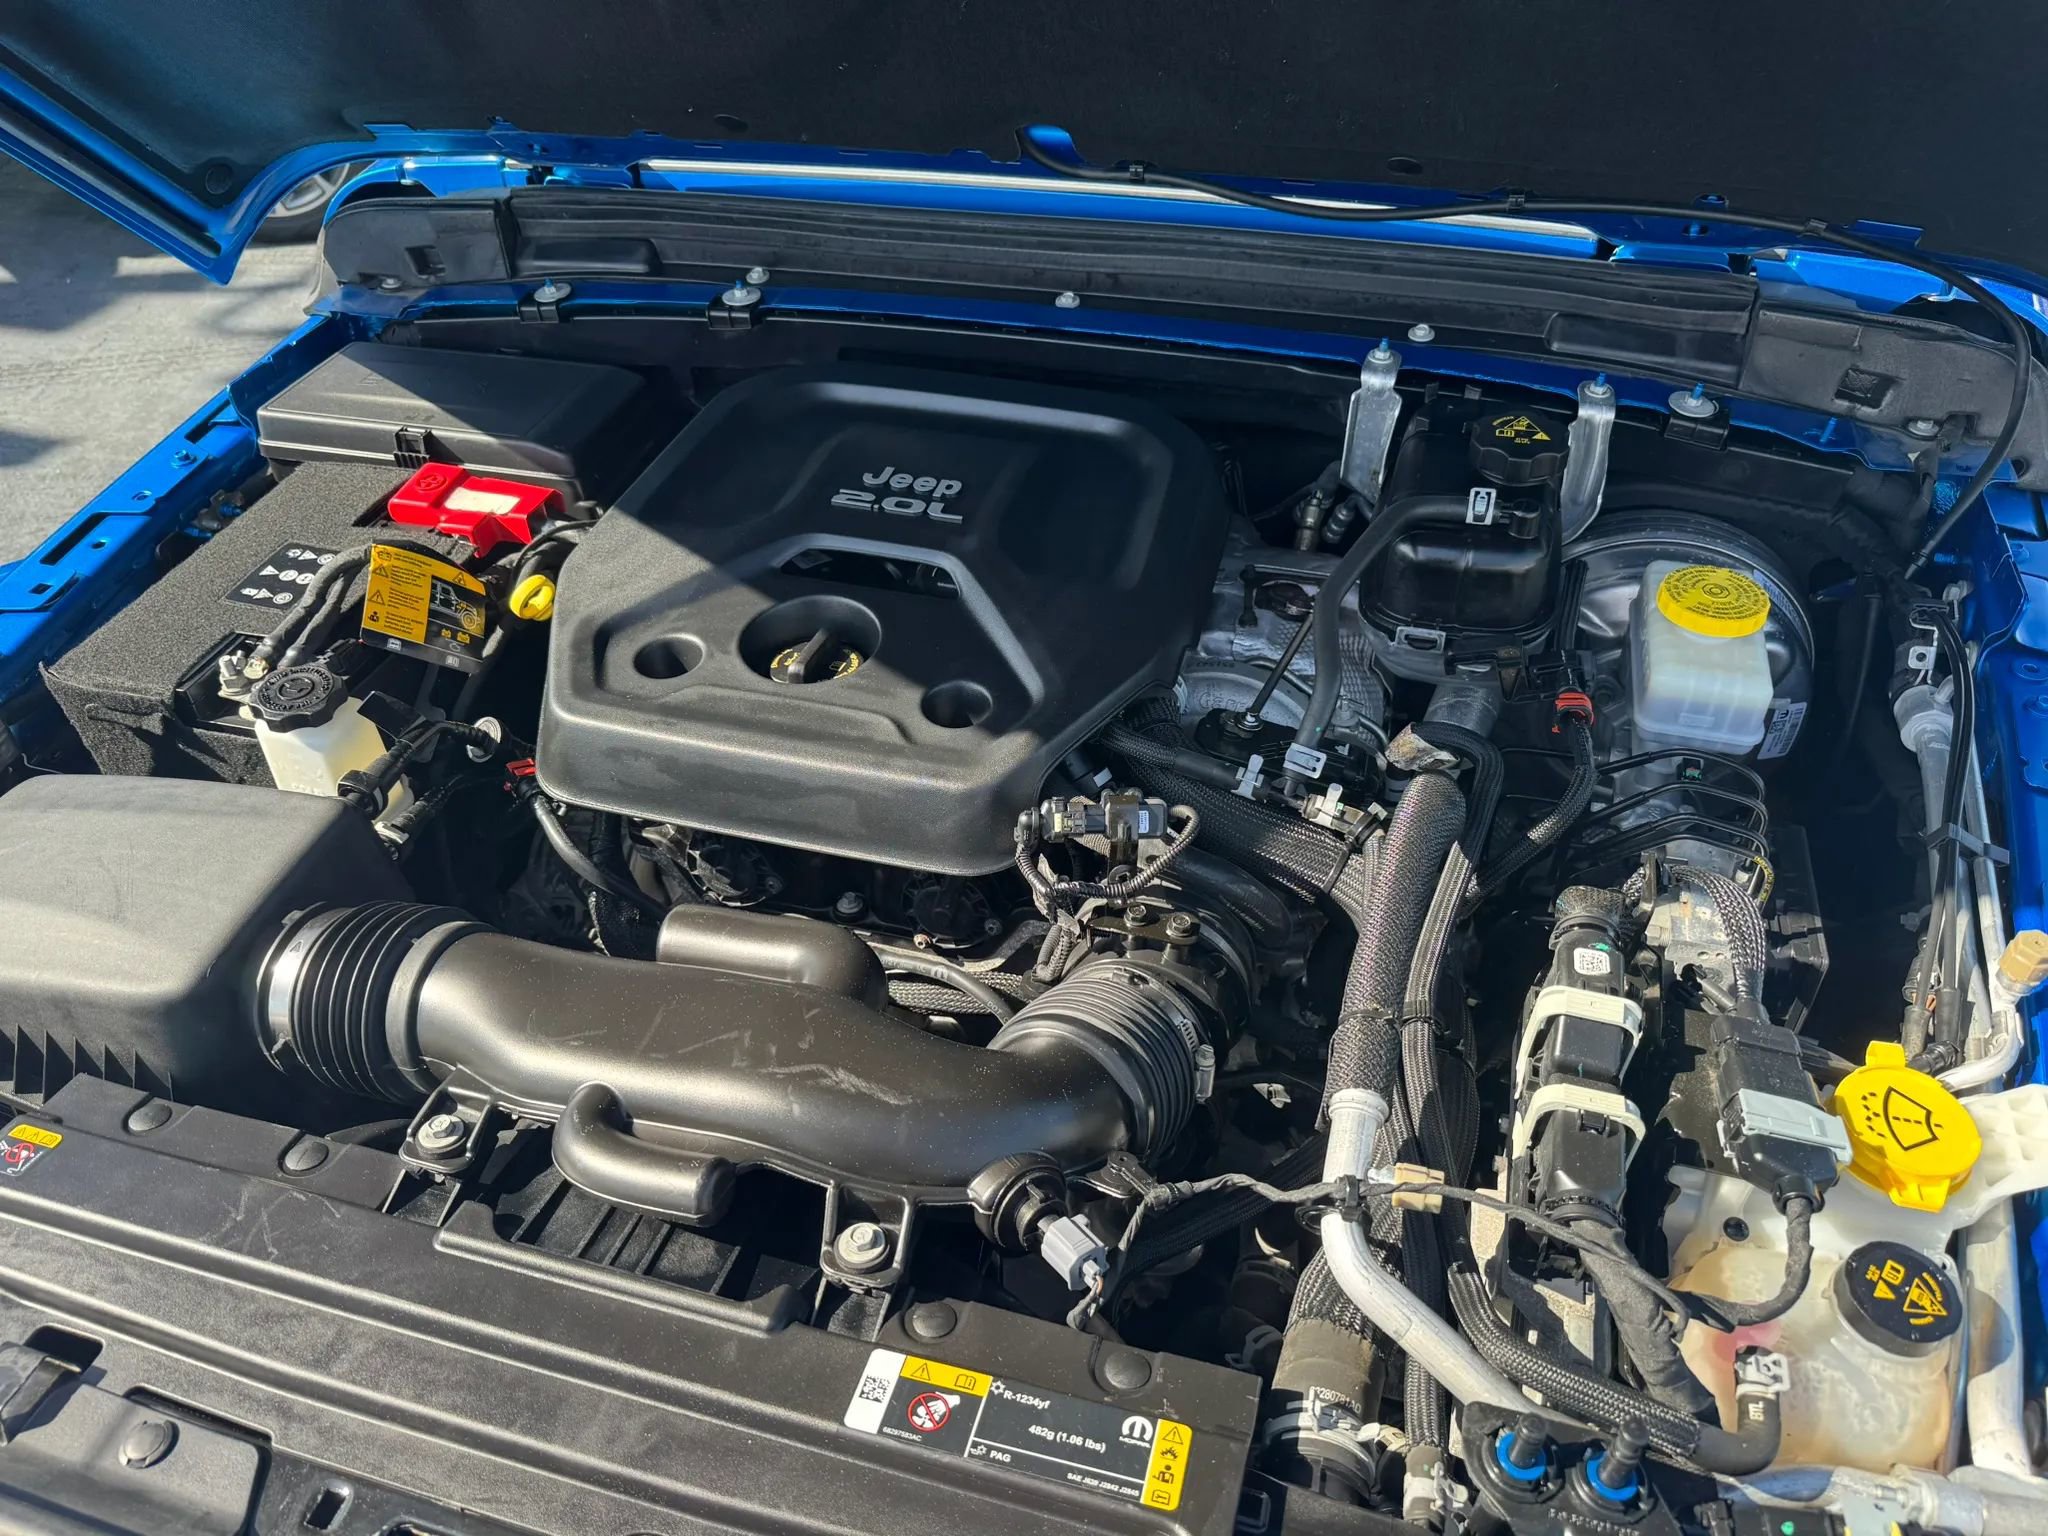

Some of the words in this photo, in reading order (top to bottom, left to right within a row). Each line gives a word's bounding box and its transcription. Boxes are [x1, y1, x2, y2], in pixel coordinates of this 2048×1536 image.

[862, 466, 962, 498] Jeep
[831, 488, 963, 522] 2.0L
[1003, 1389, 1050, 1409] R-1234yf
[1028, 1424, 1055, 1441] 482g
[1056, 1432, 1083, 1447] (1.06
[1084, 1439, 1106, 1454] lbs)
[990, 1450, 1011, 1463] PAG
[1067, 1472, 1082, 1482] SAE
